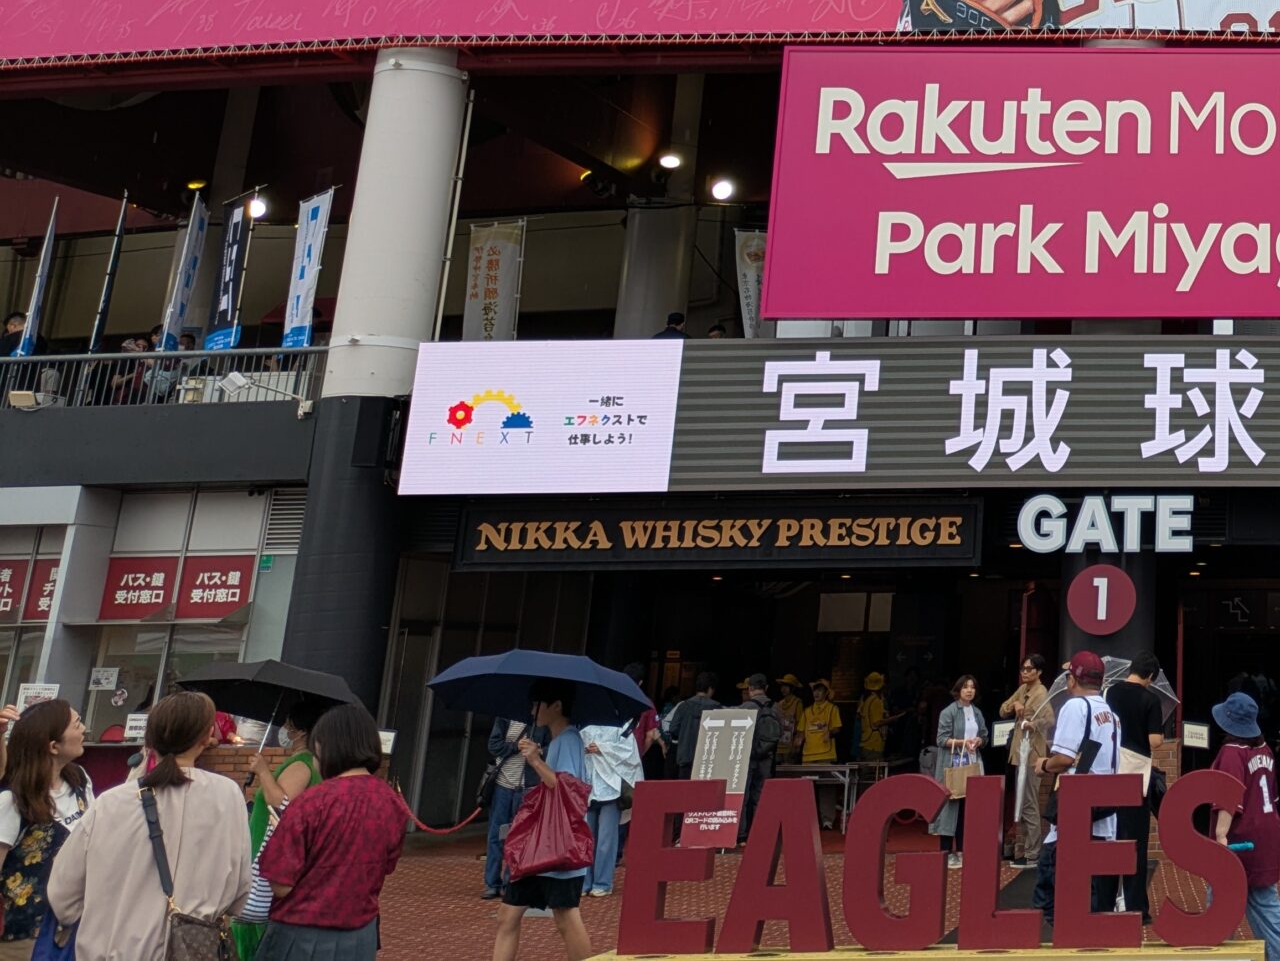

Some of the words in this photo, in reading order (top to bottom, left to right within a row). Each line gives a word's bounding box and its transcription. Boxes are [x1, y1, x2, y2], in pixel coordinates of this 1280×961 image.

[815, 83, 1151, 155] Rakuten
[874, 204, 1063, 275] Park
[563, 414, 648, 426] エフネクストで
[588, 395, 625, 407] 一緒に
[475, 521, 613, 550] NIKKA
[620, 518, 773, 549] WHISKY
[776, 516, 963, 547] PRESTIGE
[1017, 495, 1194, 554] GATE
[114, 590, 165, 604] 受付窓口
[190, 588, 240, 603] 受付窓口
[1091, 577, 1108, 620] 1
[1259, 774, 1274, 814] 1
[616, 769, 1248, 954] EAGLES
